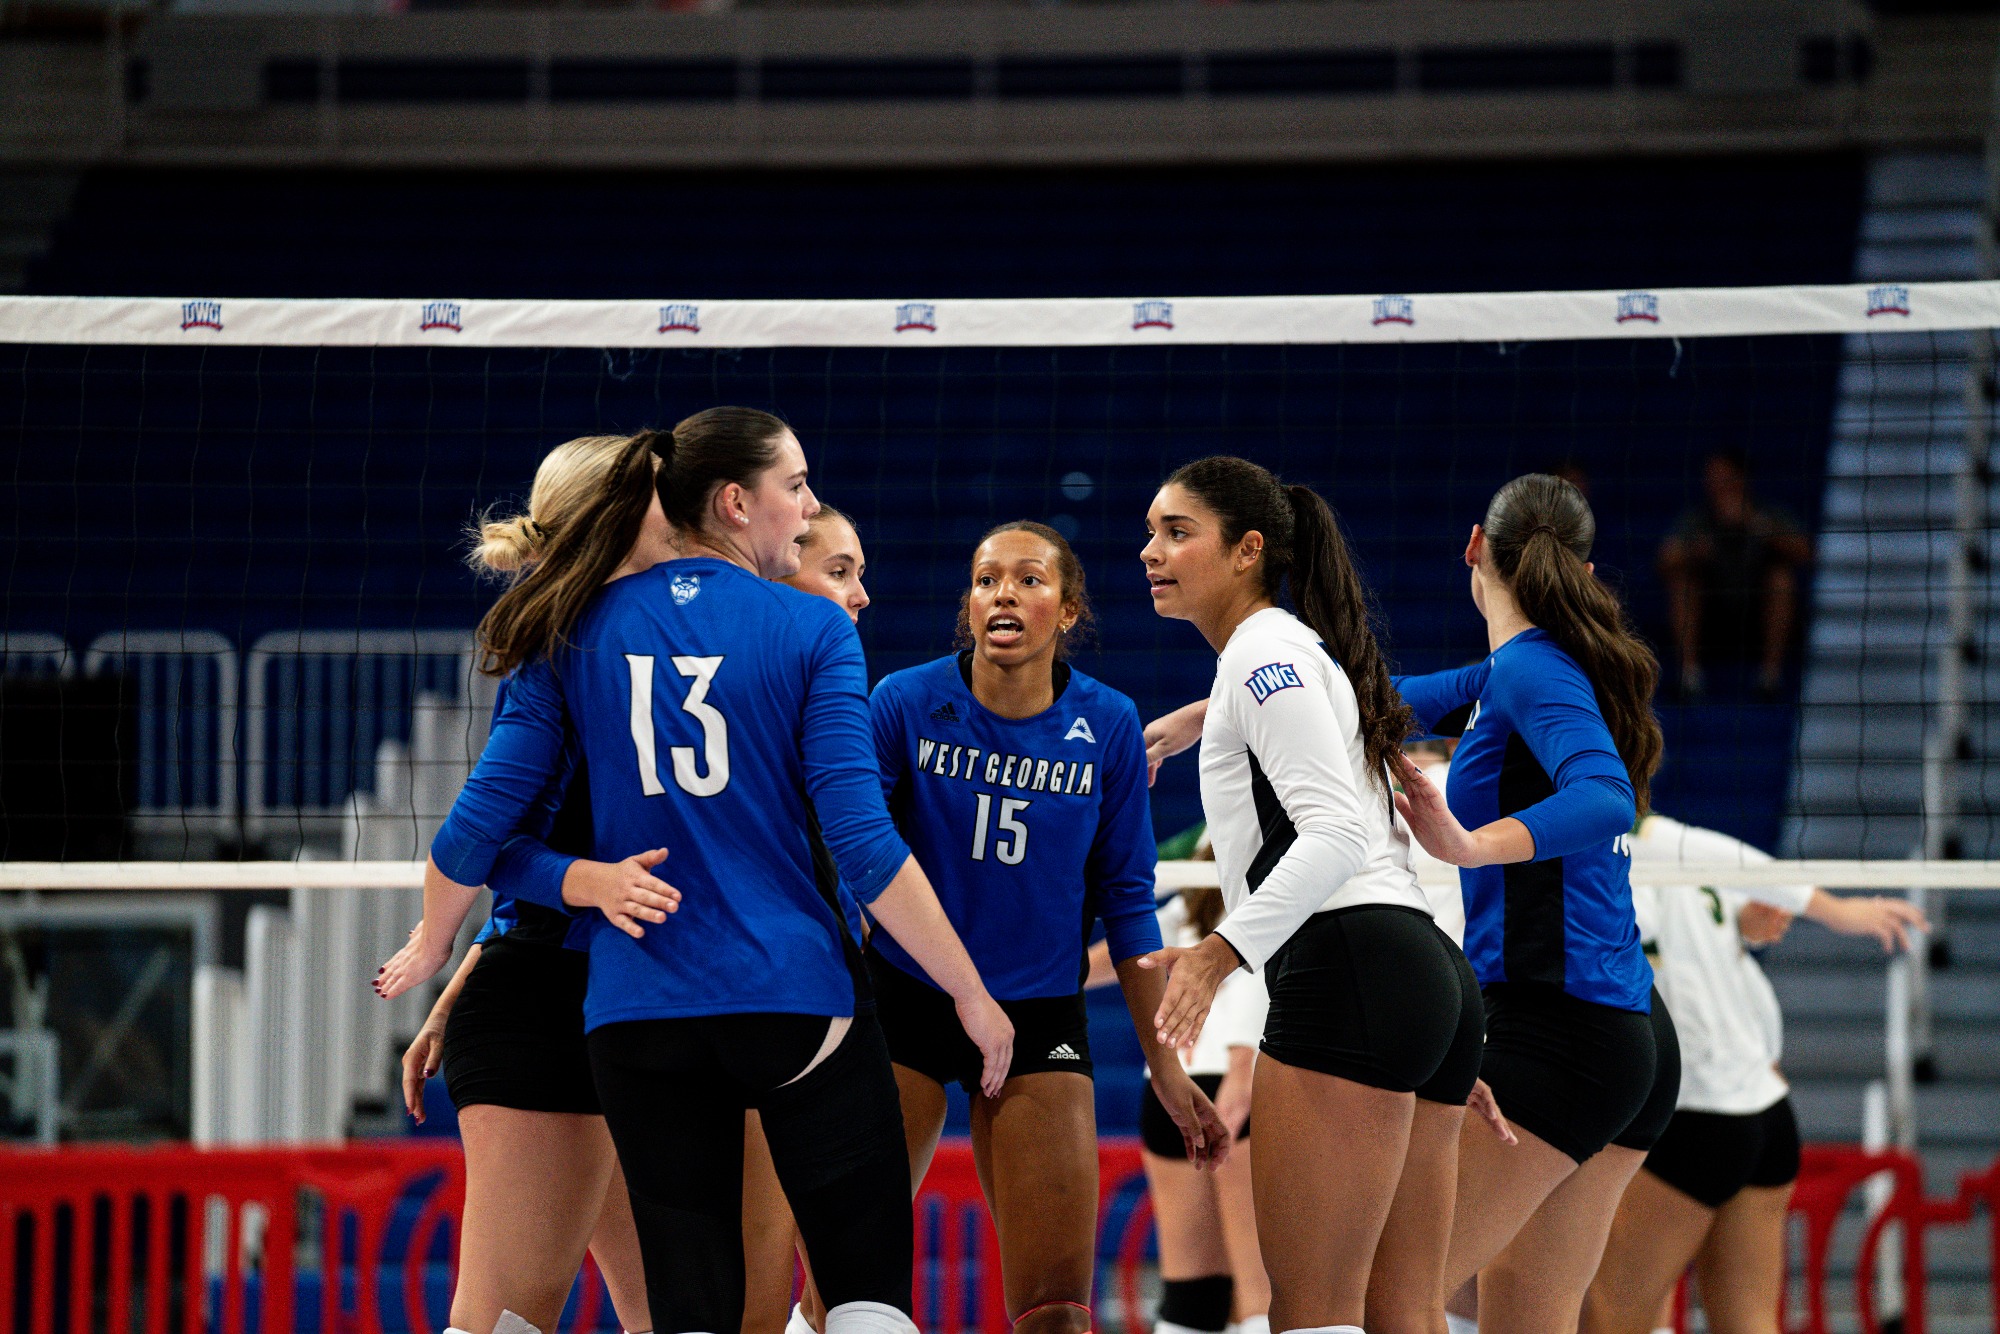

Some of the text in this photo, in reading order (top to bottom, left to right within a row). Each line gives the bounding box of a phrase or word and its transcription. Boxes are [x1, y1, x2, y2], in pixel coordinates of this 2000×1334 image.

[182, 301, 222, 325] UWG
[422, 303, 462, 326] UWG
[1246, 663, 1302, 703] UWG
[624, 654, 730, 797] 13
[917, 738, 1094, 795] WEST GEORGIA
[971, 793, 1031, 865] 15
